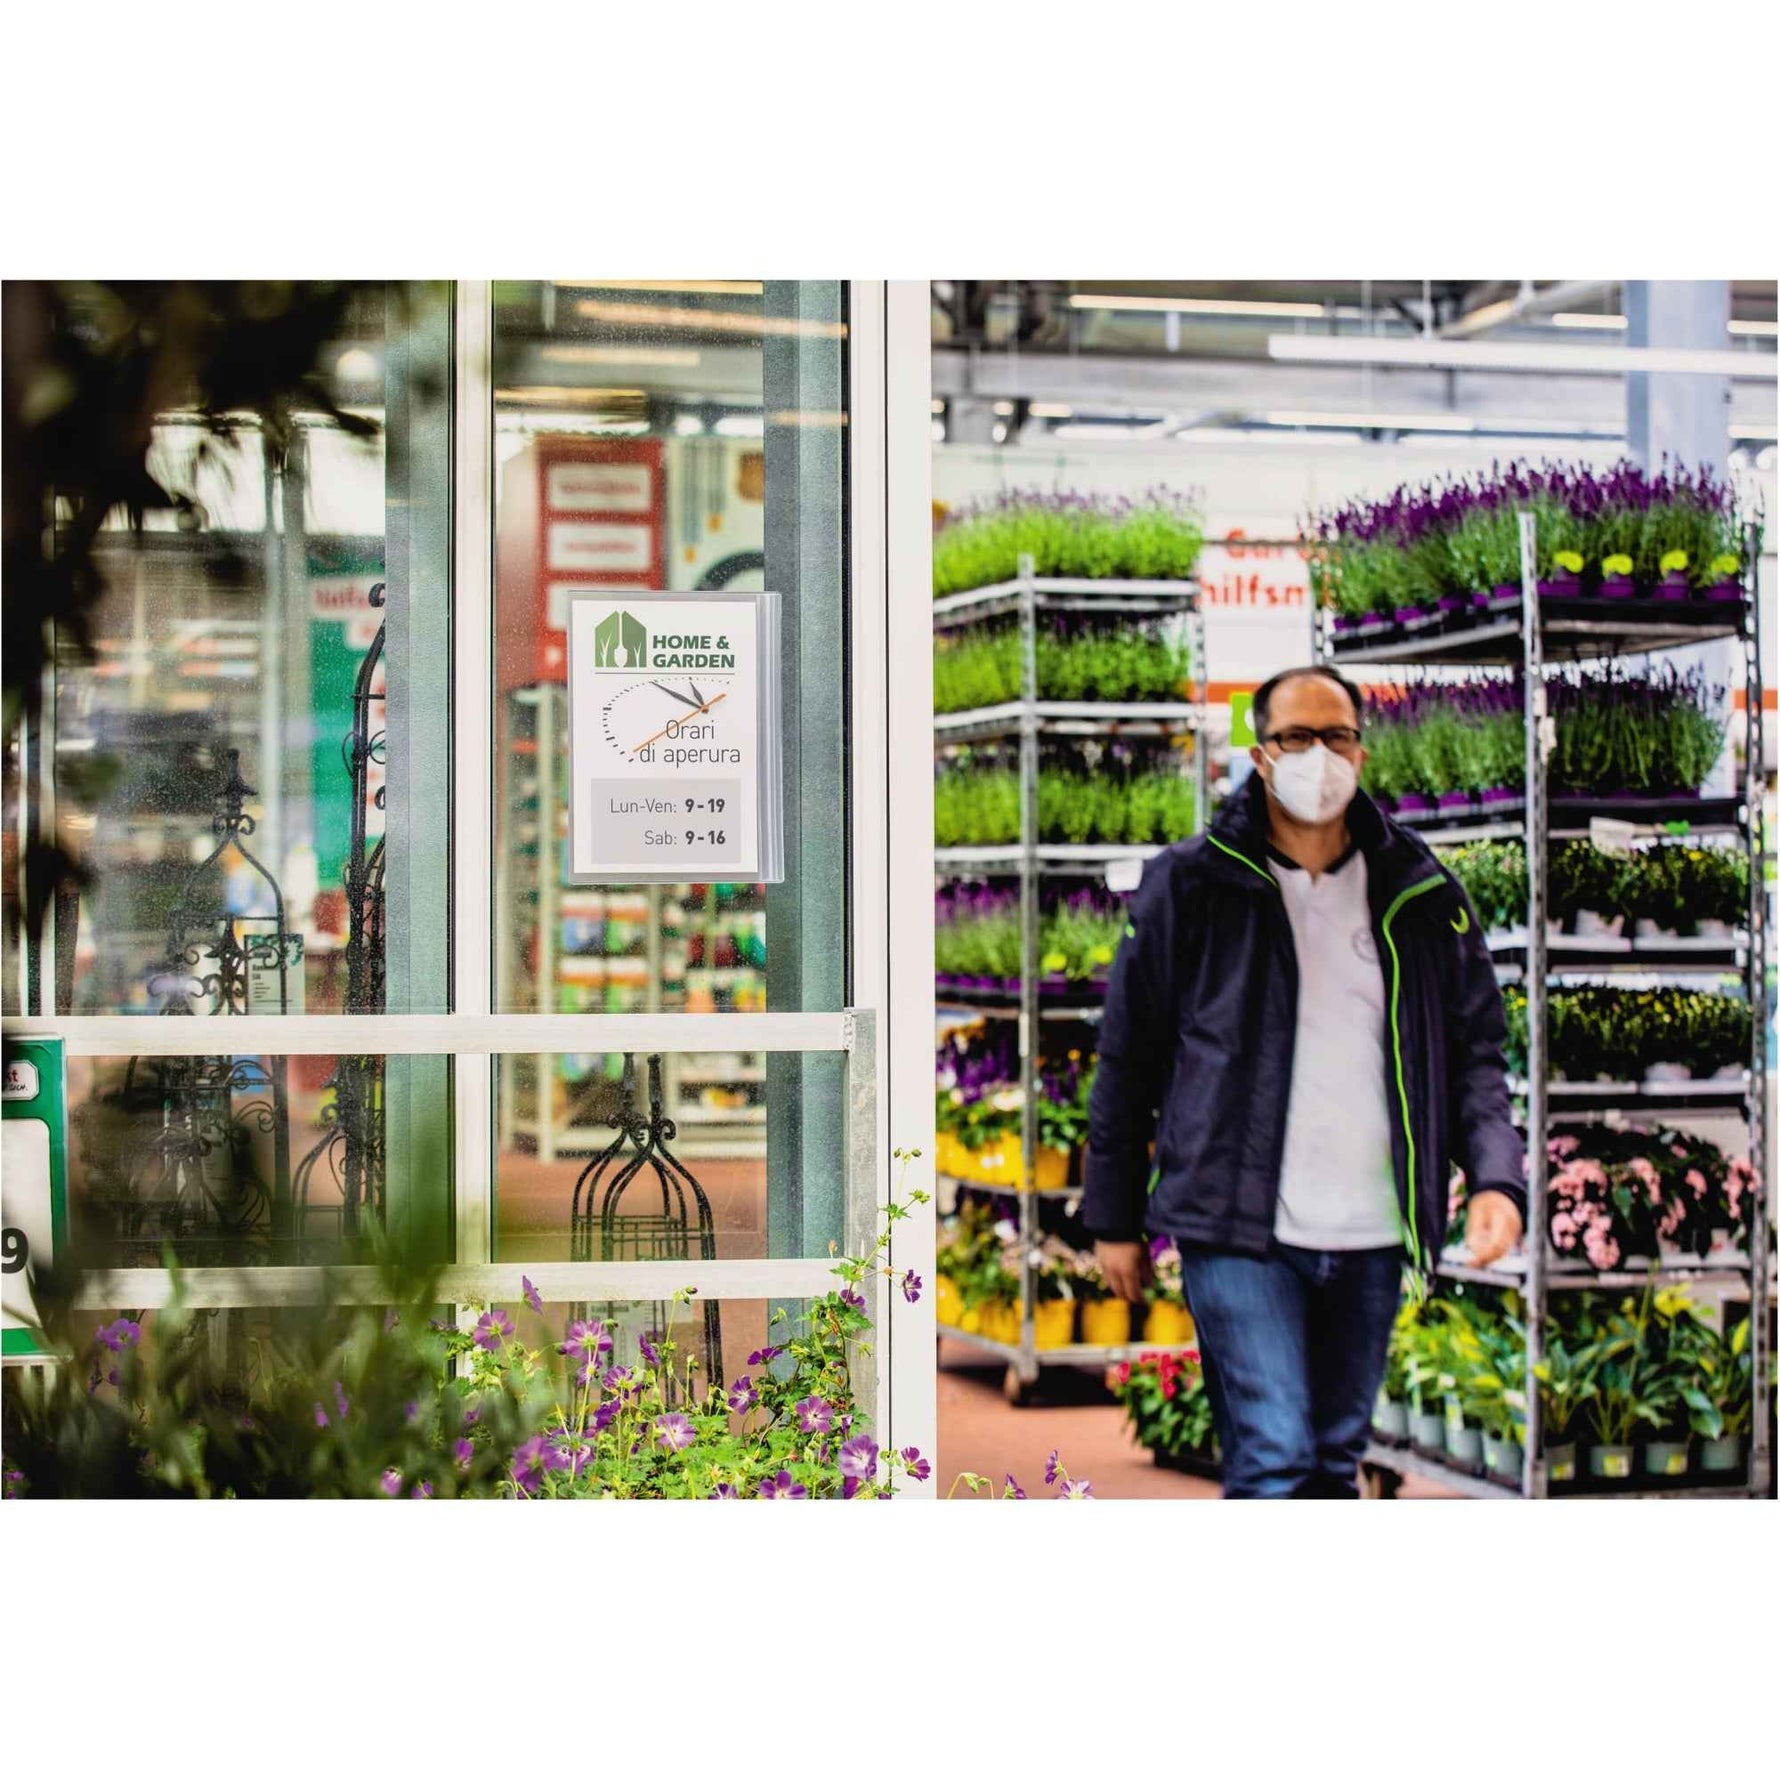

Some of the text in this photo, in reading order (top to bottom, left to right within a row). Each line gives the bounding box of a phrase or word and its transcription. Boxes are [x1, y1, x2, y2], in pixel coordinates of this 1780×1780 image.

[652, 635, 730, 650] HOME &
[652, 653, 735, 668] GARDEN
[665, 719, 715, 740] Orari
[639, 743, 741, 768] di aperura
[610, 798, 677, 814] Lun-Ven:
[644, 830, 677, 845] Sab:
[2, 1228, 28, 1274] 9
